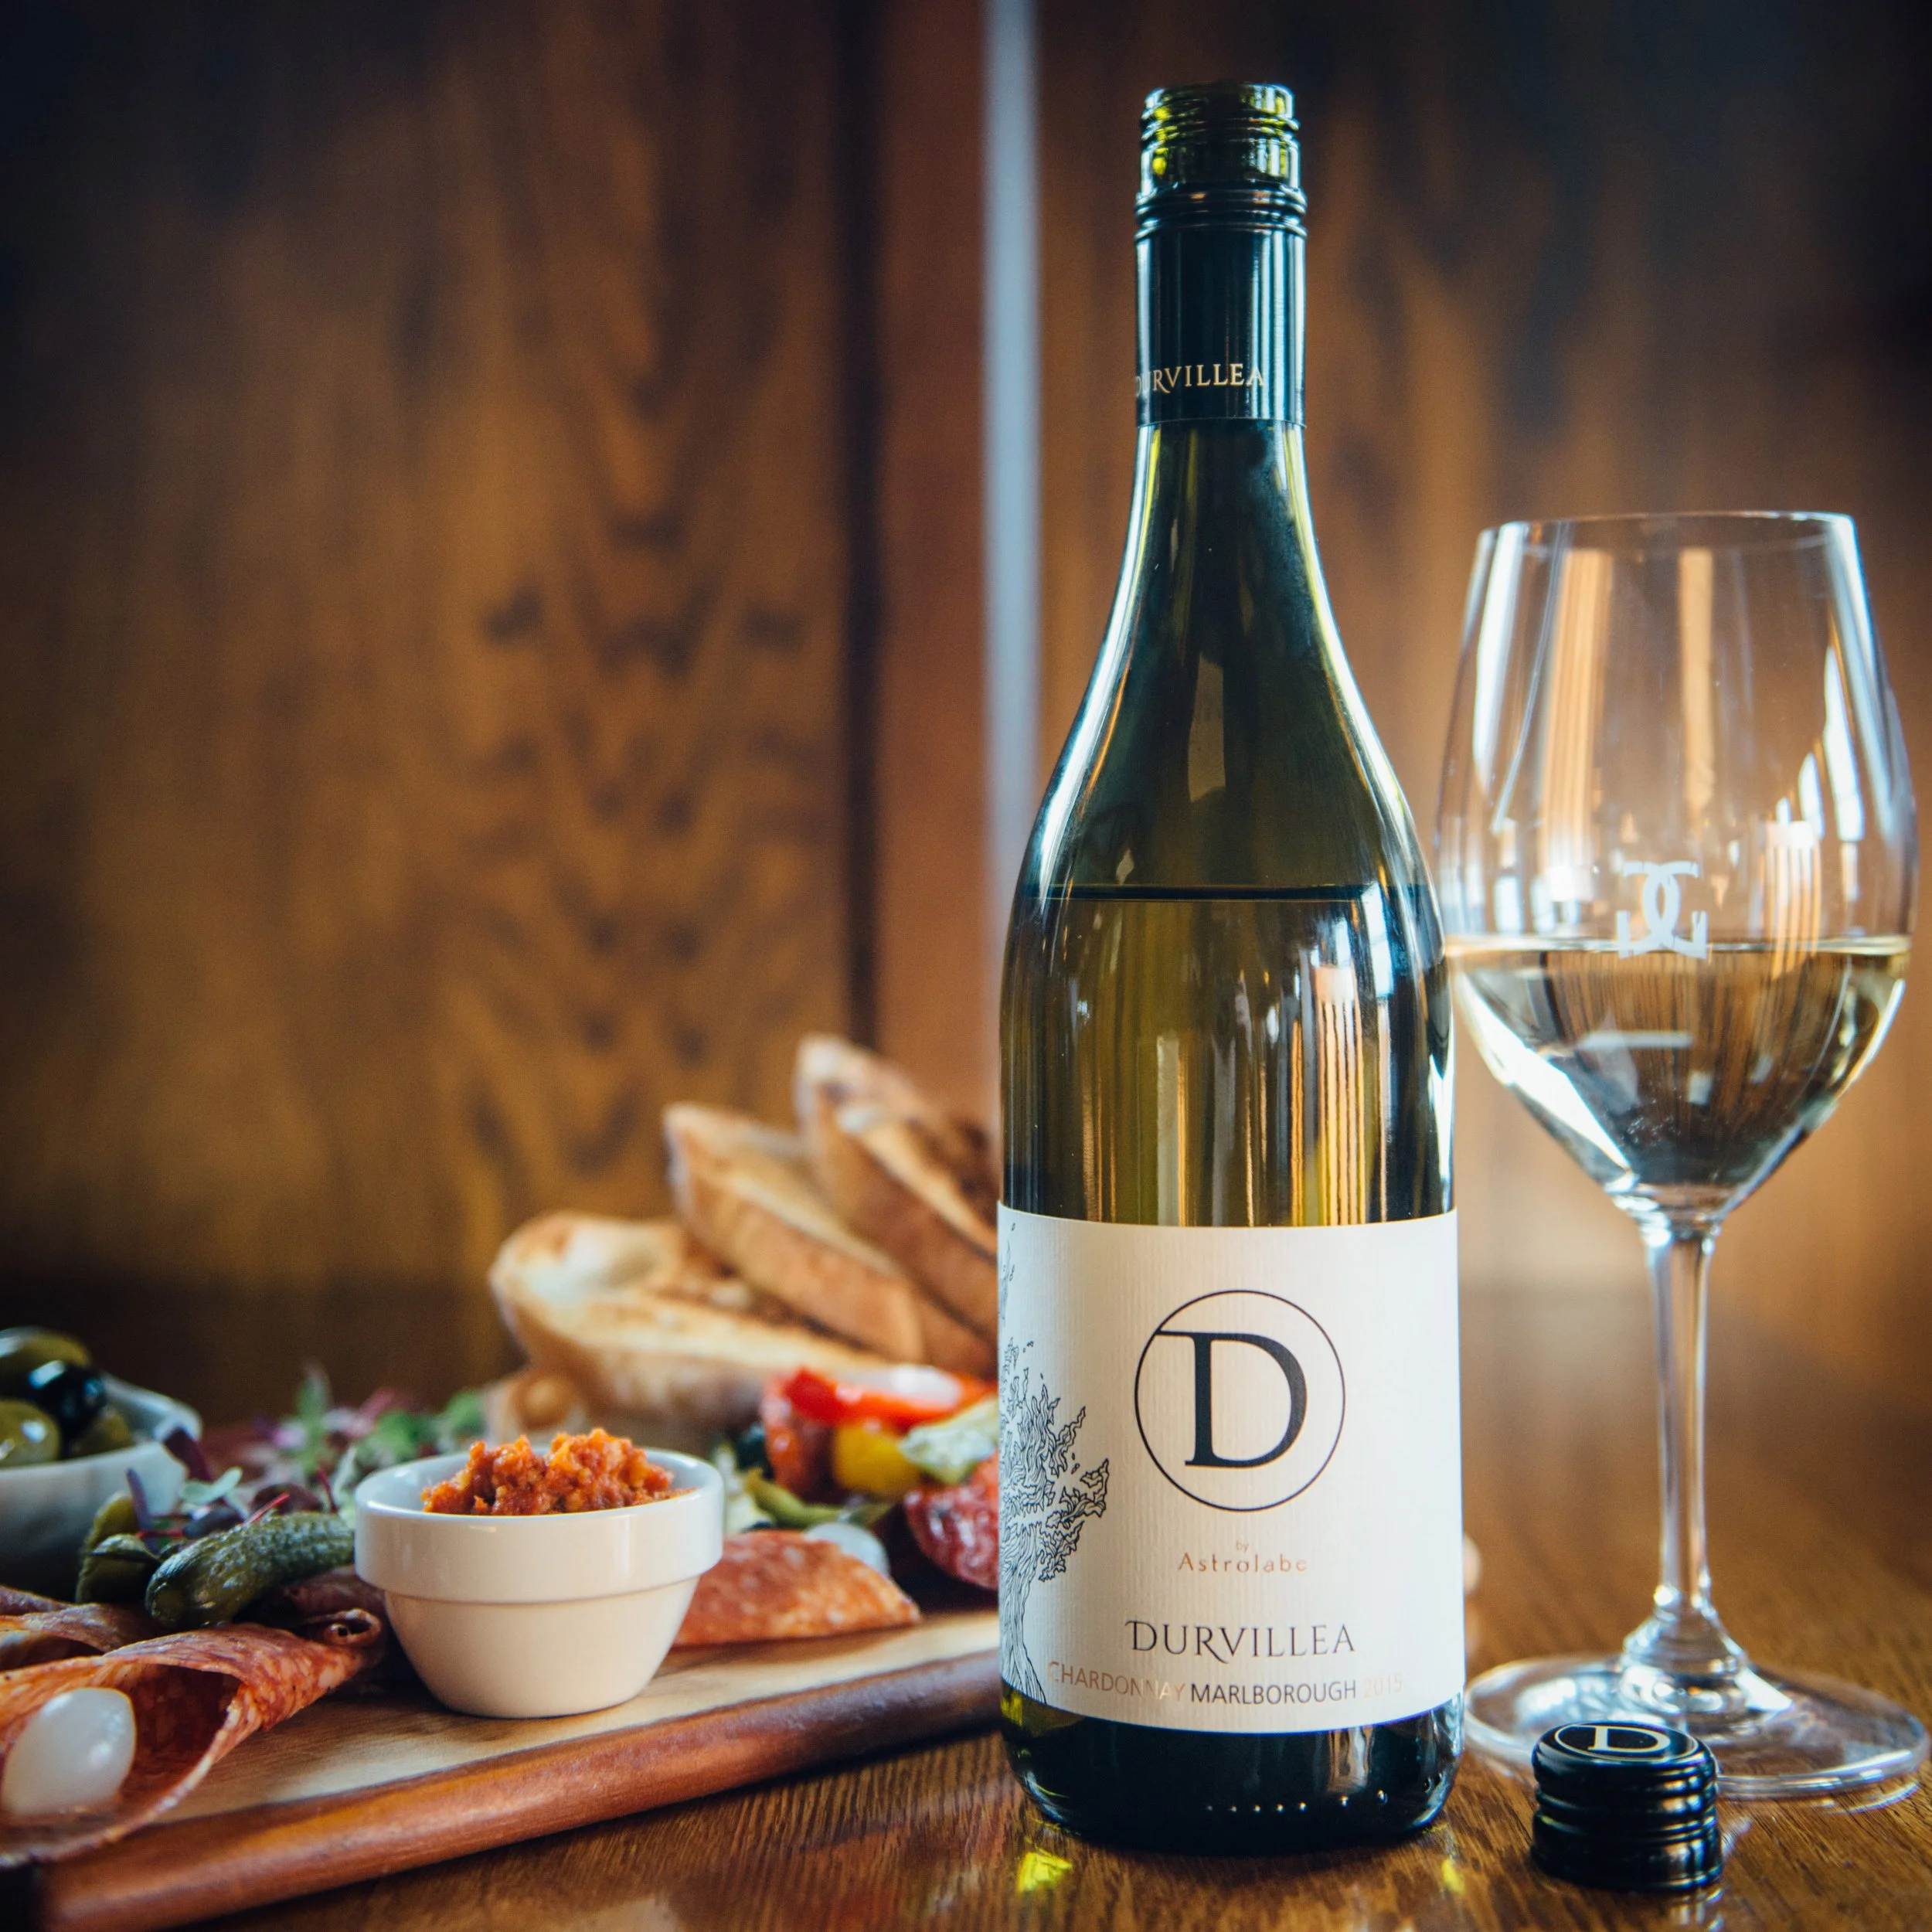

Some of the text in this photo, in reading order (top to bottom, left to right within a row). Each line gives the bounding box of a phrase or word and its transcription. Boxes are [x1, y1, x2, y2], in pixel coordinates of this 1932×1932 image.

[1155, 1328, 1307, 1468] D
[1178, 1552, 1308, 1573] Astrolabe
[1236, 1539, 1250, 1552] by
[1125, 1620, 1355, 1664] DURVILLEA
[1047, 1661, 1403, 1705] CHARDONNAY MARLBOROUGH 2015
